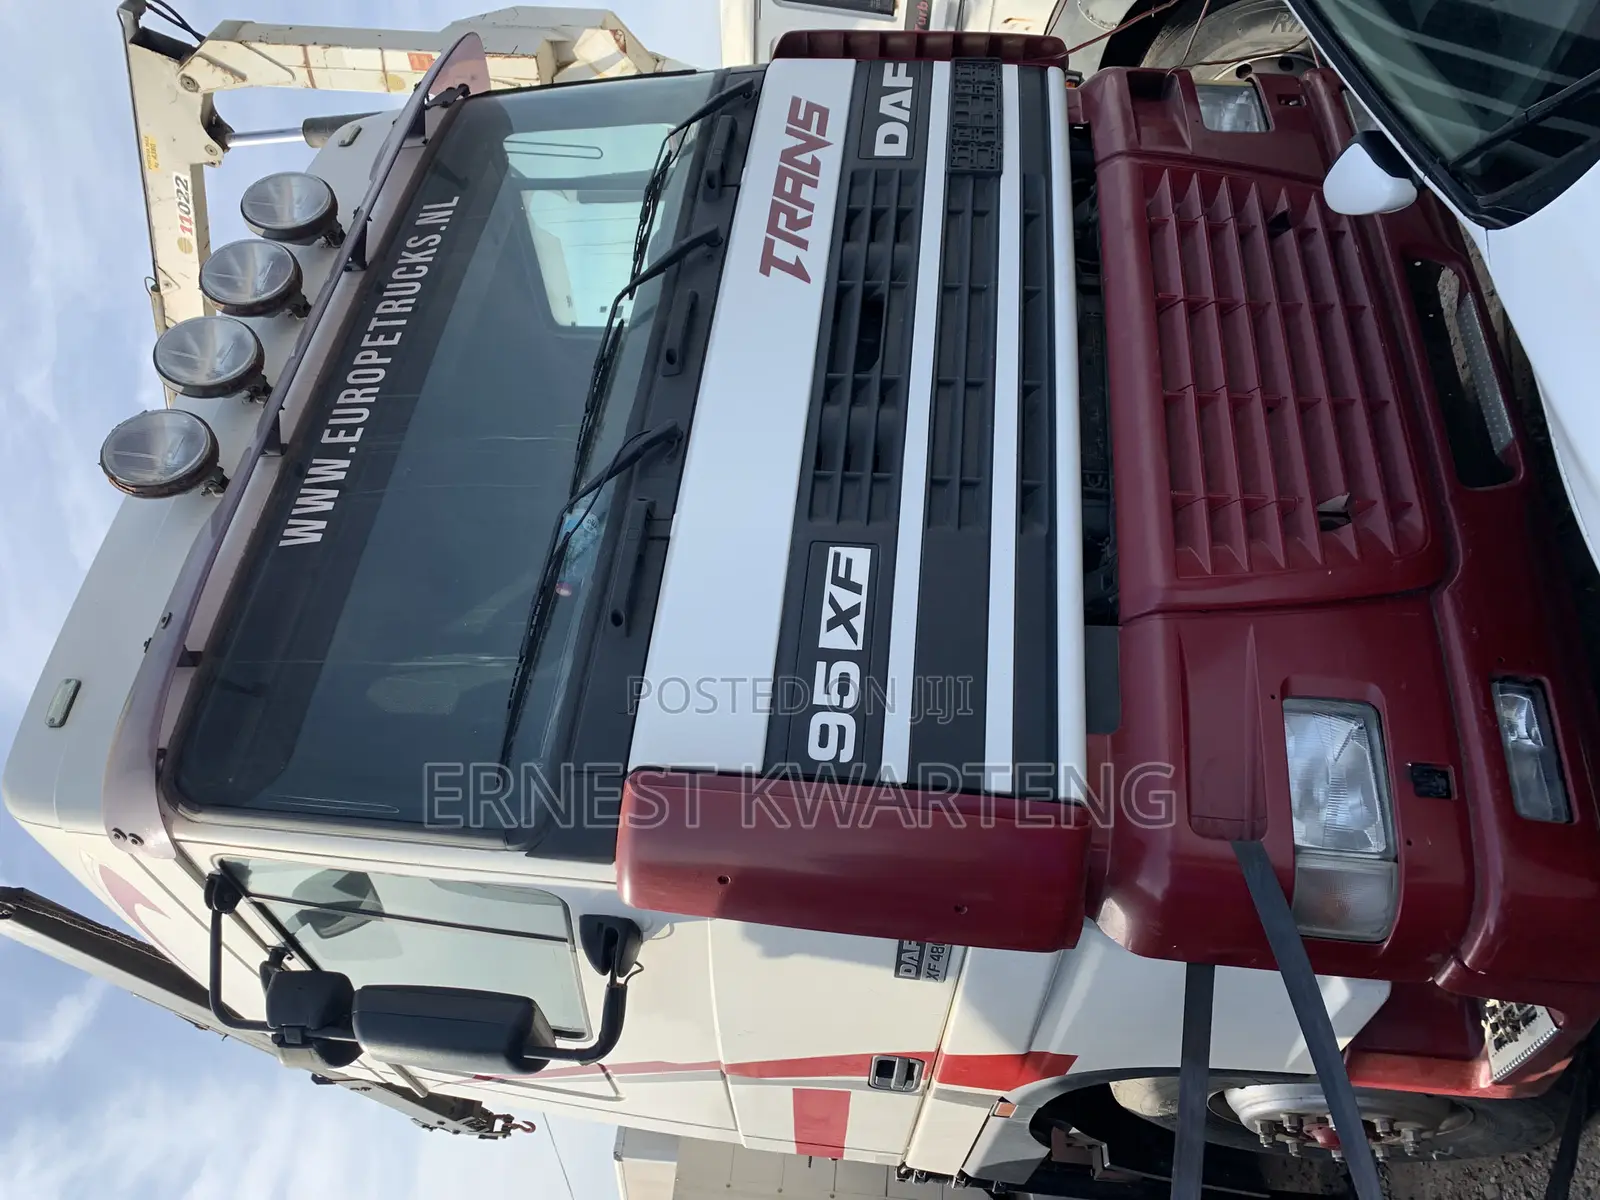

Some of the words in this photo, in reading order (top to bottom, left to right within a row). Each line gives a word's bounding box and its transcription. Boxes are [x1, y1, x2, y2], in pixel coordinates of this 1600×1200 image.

[913, 0, 929, 31] Turb
[873, 61, 914, 157] DAF
[174, 174, 194, 237] 11022
[759, 95, 834, 284] TRANS
[278, 195, 460, 547] WWW.EUROPETRUCKS.NL
[826, 549, 863, 646] XF
[807, 660, 861, 764] 95
[898, 940, 920, 978] DAF
[925, 962, 941, 982] XF
